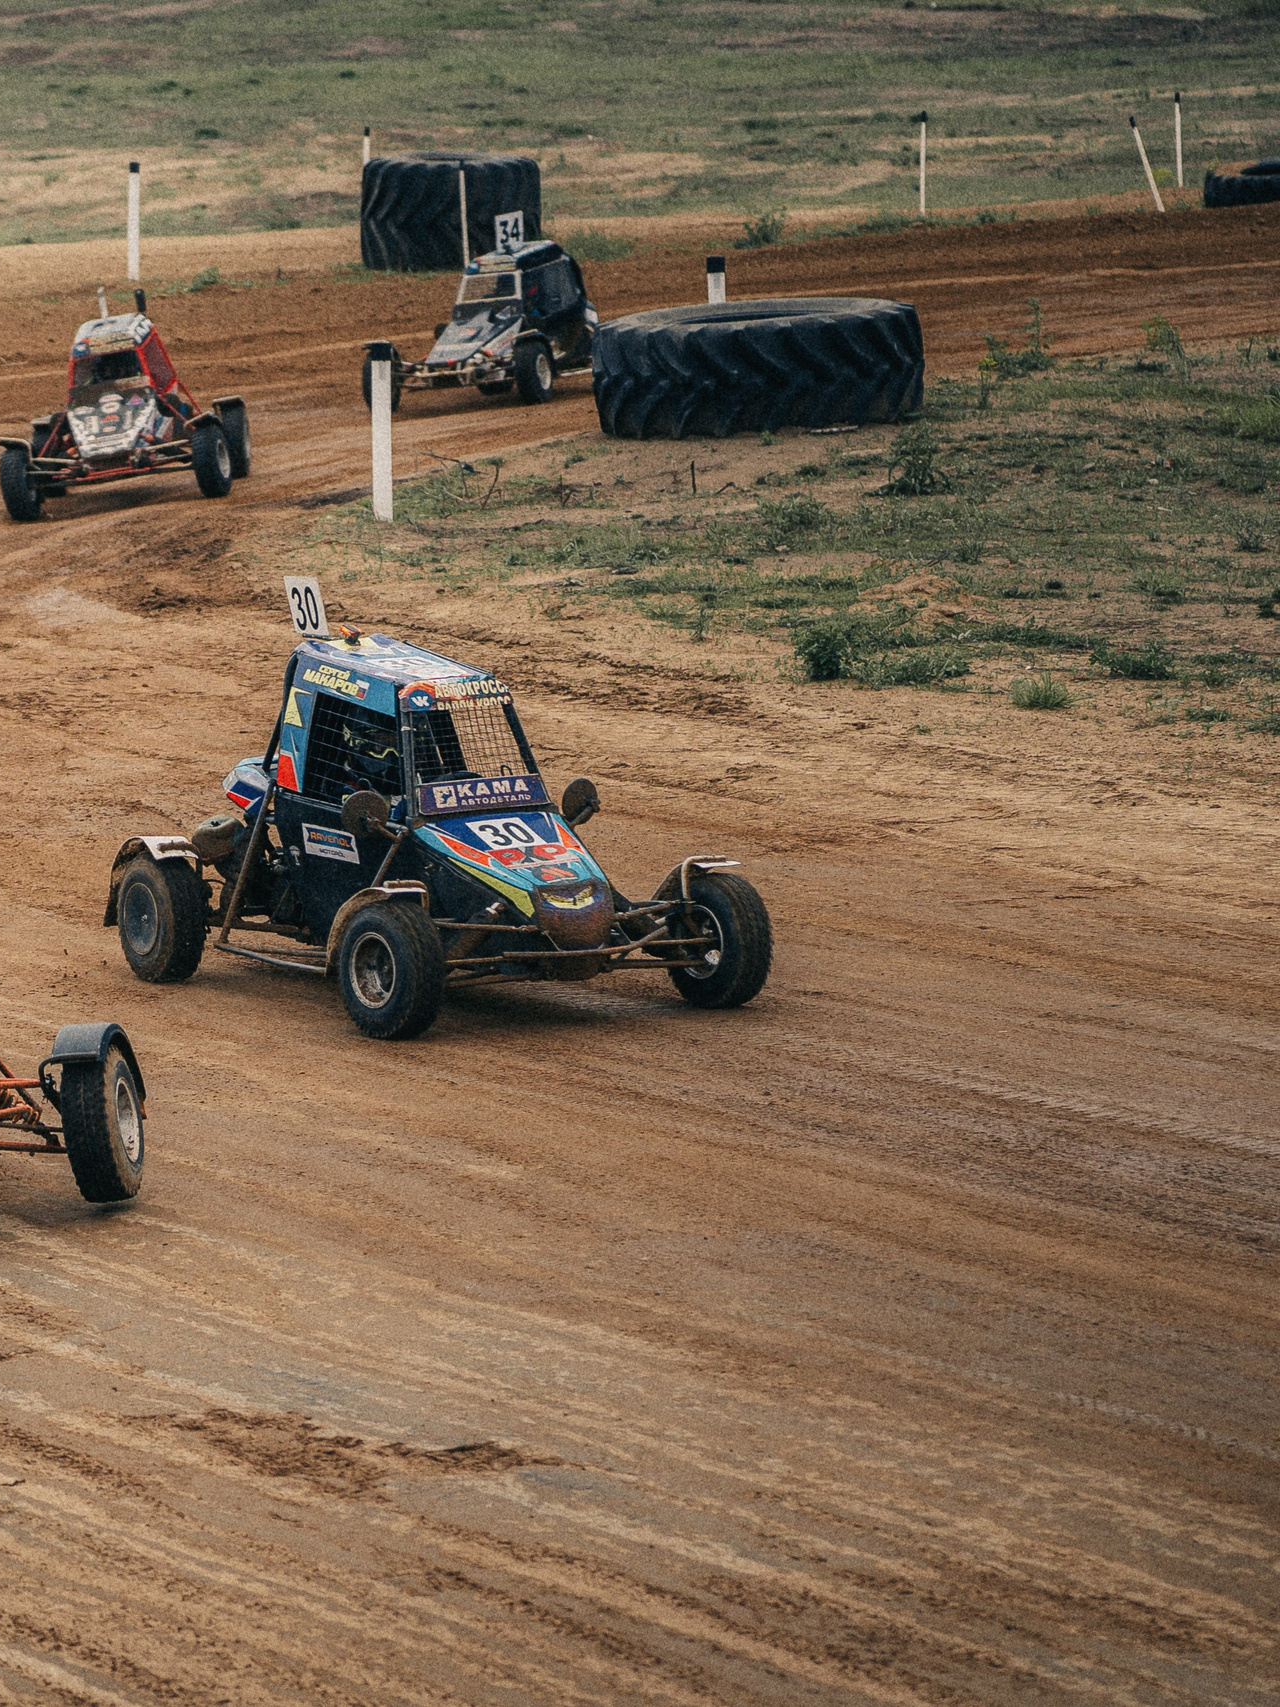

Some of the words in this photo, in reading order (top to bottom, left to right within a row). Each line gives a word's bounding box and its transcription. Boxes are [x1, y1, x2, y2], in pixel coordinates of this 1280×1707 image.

[499, 218, 521, 244] 34
[291, 586, 319, 631] 30
[302, 668, 359, 697] МАКАРОВ
[318, 664, 351, 680] СЕРГЕЙ
[457, 778, 530, 798] КАМА
[461, 793, 533, 807] АВТОДЕТАЛЬ
[309, 831, 351, 848] RAVENOL
[478, 821, 535, 846] 30
